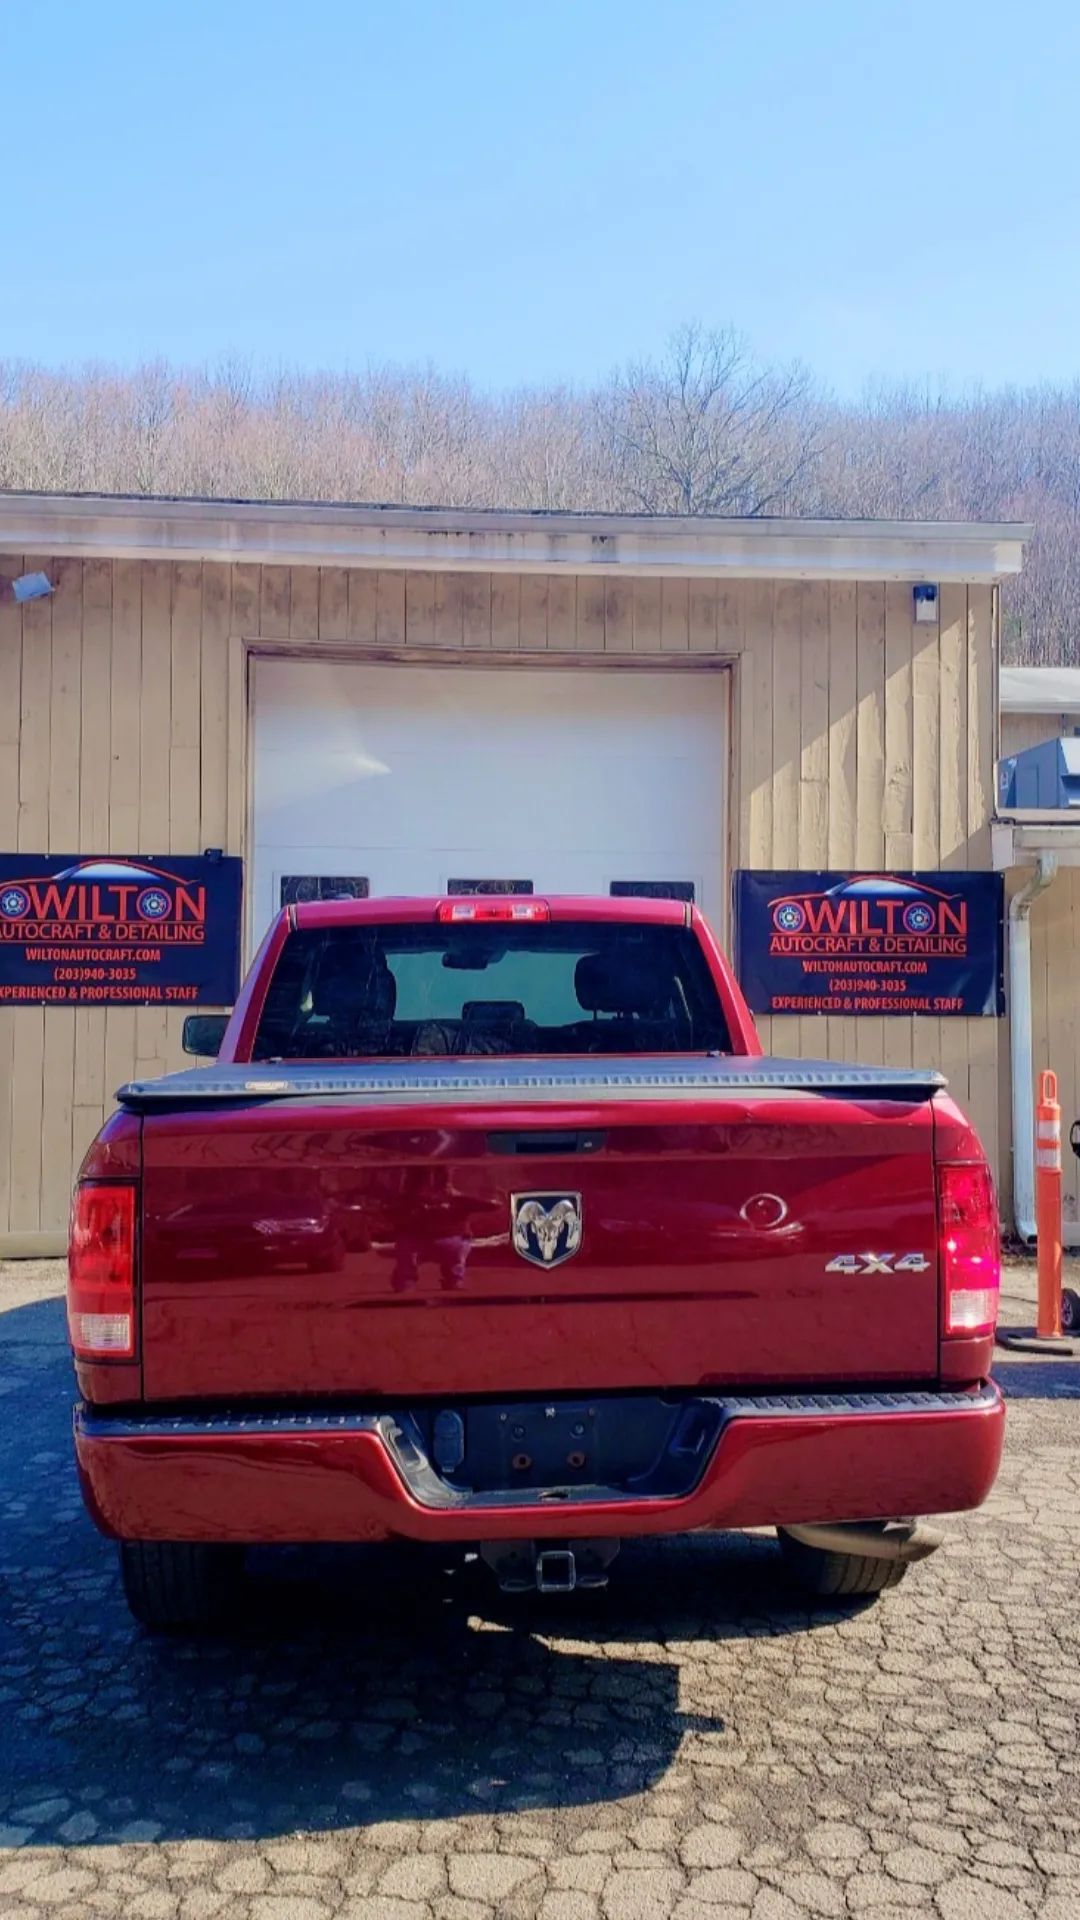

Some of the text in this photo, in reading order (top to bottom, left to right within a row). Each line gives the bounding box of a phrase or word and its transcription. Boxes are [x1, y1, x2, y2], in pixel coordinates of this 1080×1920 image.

[0, 922, 205, 941] UTOCRAFT & DETAILING
[770, 936, 967, 953] AUTOCRAFT & DETAILING
[26, 948, 161, 961] WILTONAUTOCRAFT.COM
[803, 960, 928, 973] WILTONAUTOCRAFT.COM
[54, 966, 136, 981] (203)940-3035
[0, 986, 199, 999] XPERIENCED & PROFESSIONAL STAFF
[772, 997, 841, 1010] EXPERIENCED
[854, 997, 930, 1010] PROFESSIONAL
[933, 997, 964, 1010] STAFF
